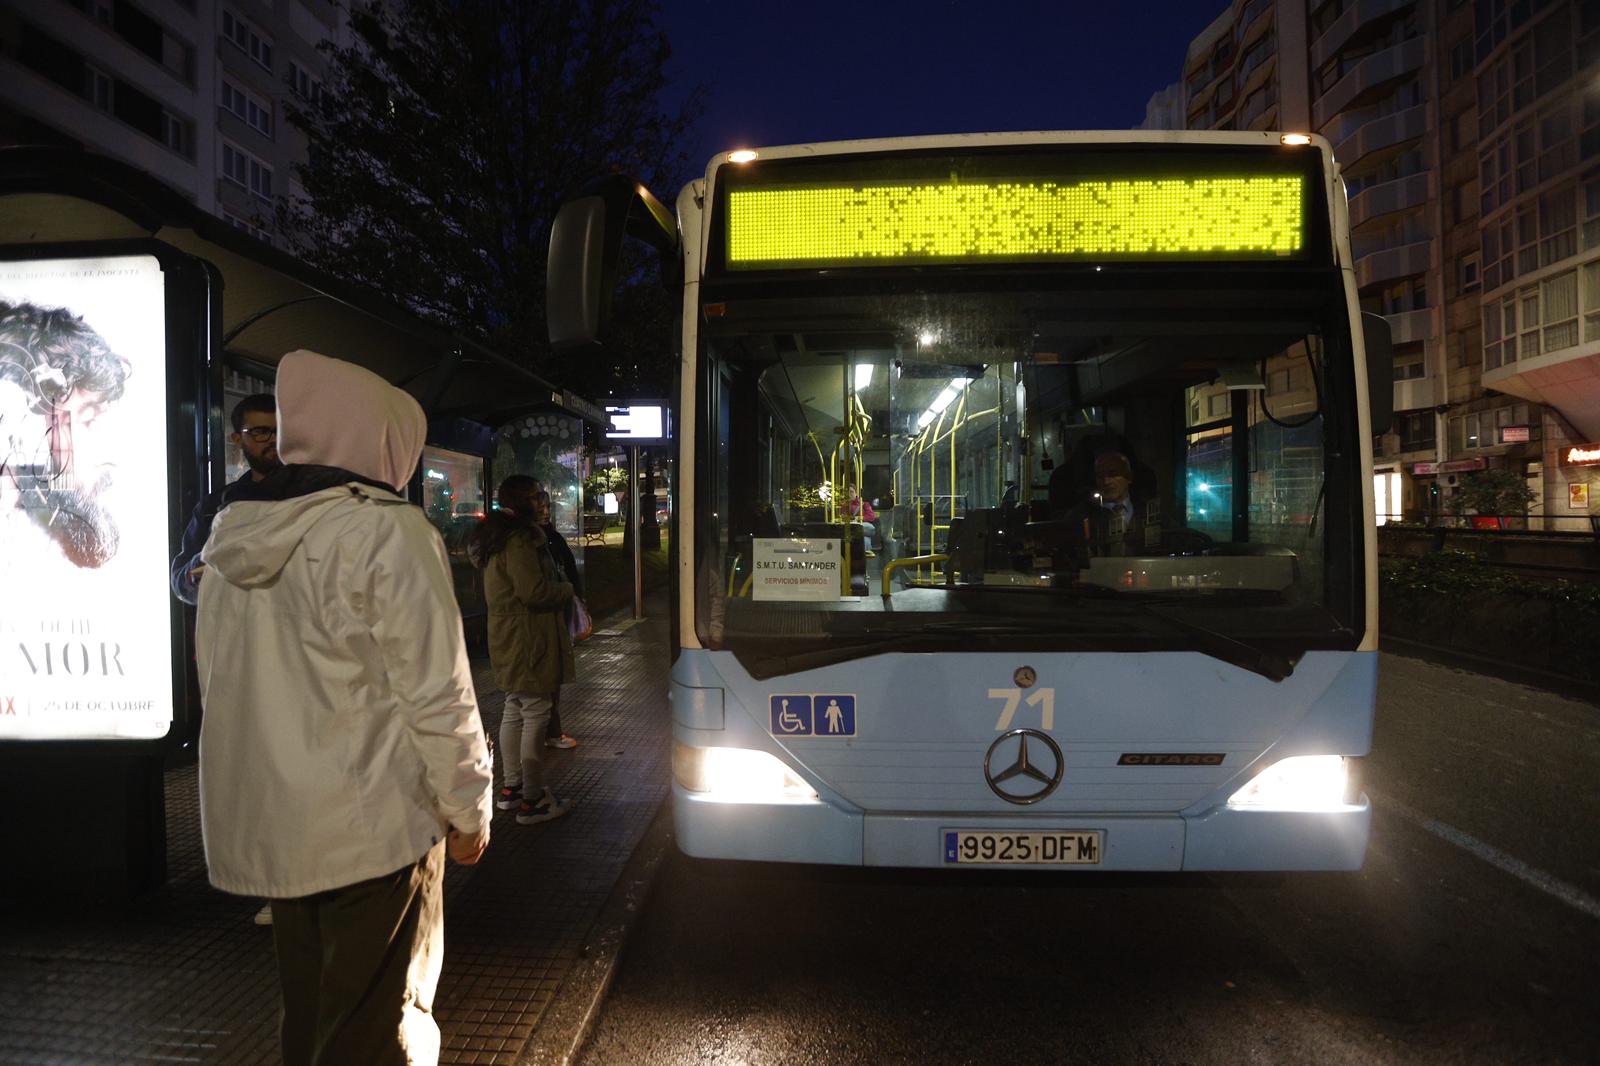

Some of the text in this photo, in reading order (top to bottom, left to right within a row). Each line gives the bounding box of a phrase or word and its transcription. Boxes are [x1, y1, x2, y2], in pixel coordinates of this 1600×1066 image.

[756, 561, 837, 570] S.M.T.U. SANTANDER
[764, 577, 799, 585] SERVICIOS
[0, 641, 126, 677] MOR
[64, 700, 81, 712] DE
[86, 699, 156, 712] OCTUBRE
[987, 687, 1056, 731] 71
[1123, 754, 1221, 765] CITARO
[963, 835, 1032, 861] 9925
[1041, 836, 1094, 861] DFM
